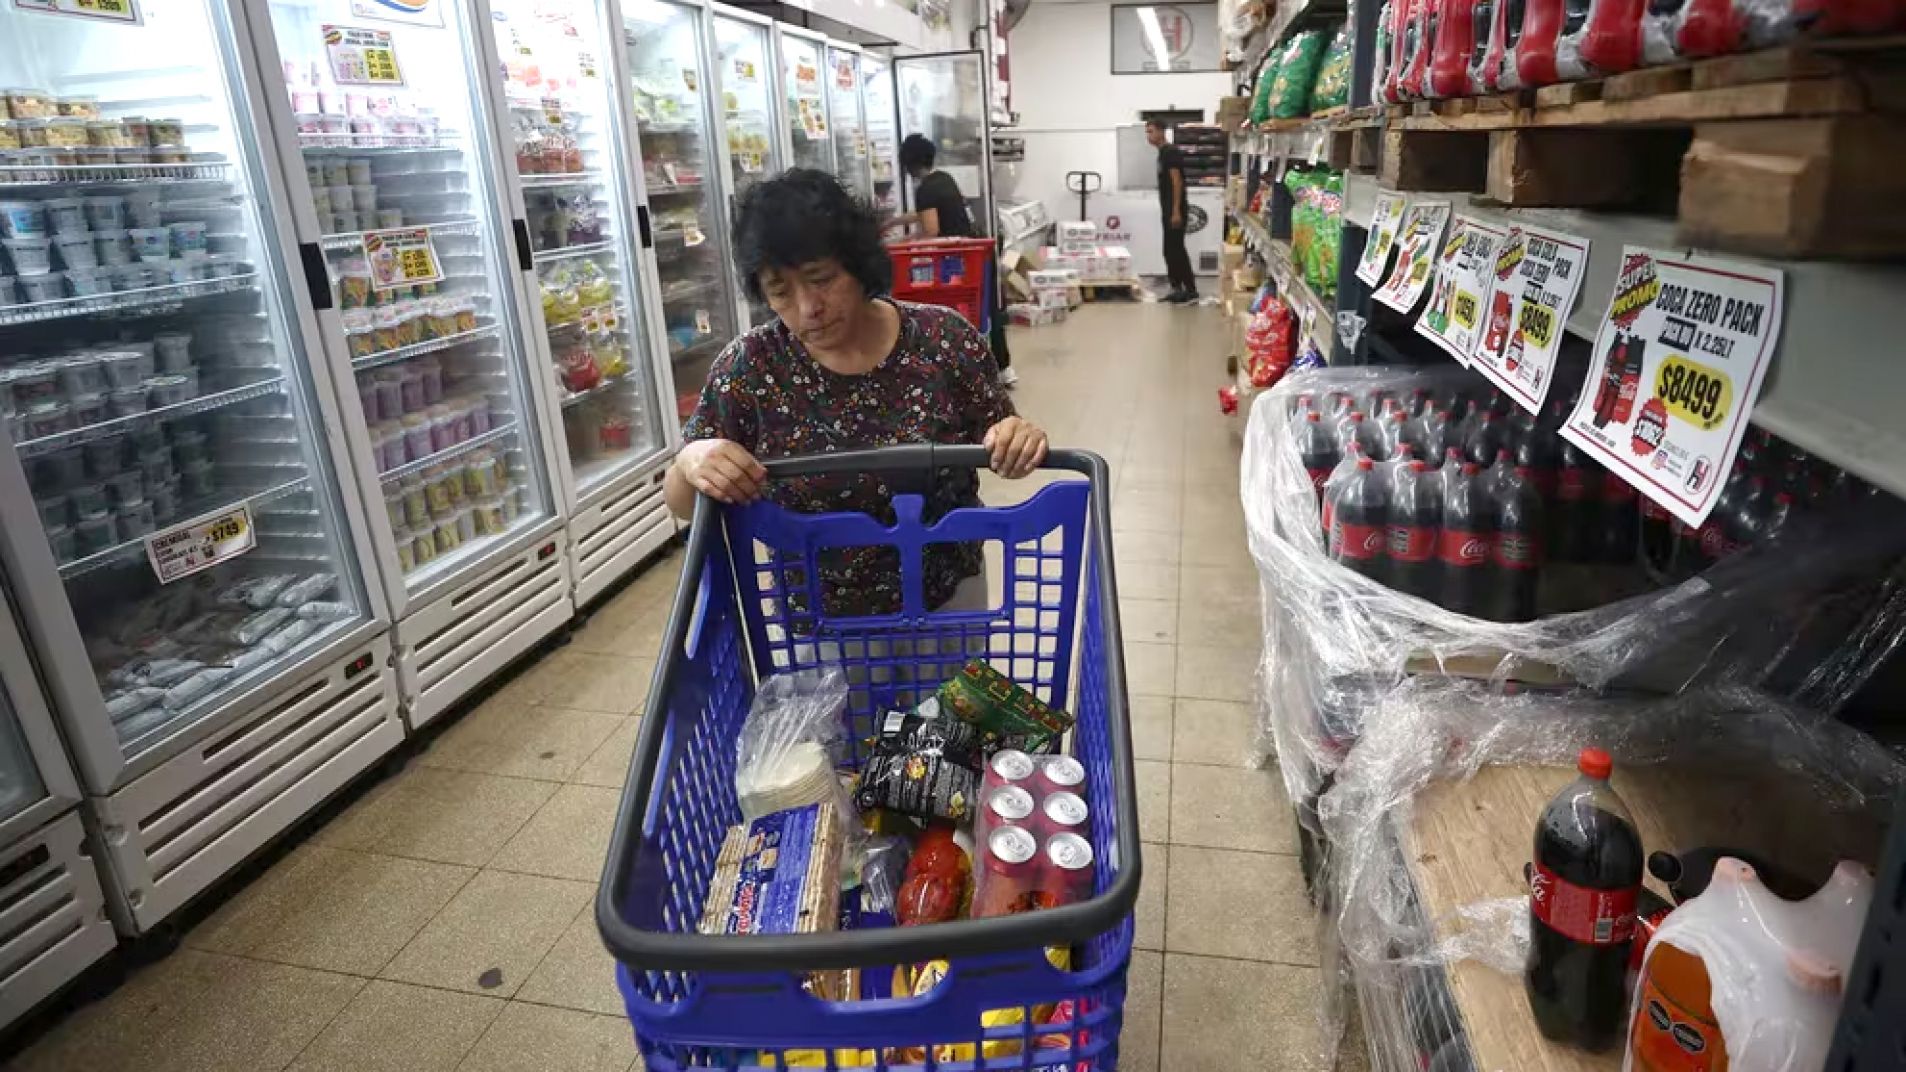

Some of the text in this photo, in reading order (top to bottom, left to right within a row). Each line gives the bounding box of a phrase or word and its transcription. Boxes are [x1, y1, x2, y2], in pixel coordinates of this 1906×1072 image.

[1656, 282, 1688, 315] COCA
[1684, 290, 1722, 326] ZERO
[1720, 298, 1765, 337] PACK
[1701, 333, 1736, 360] 2.25LT
[1658, 363, 1722, 420] $8499
